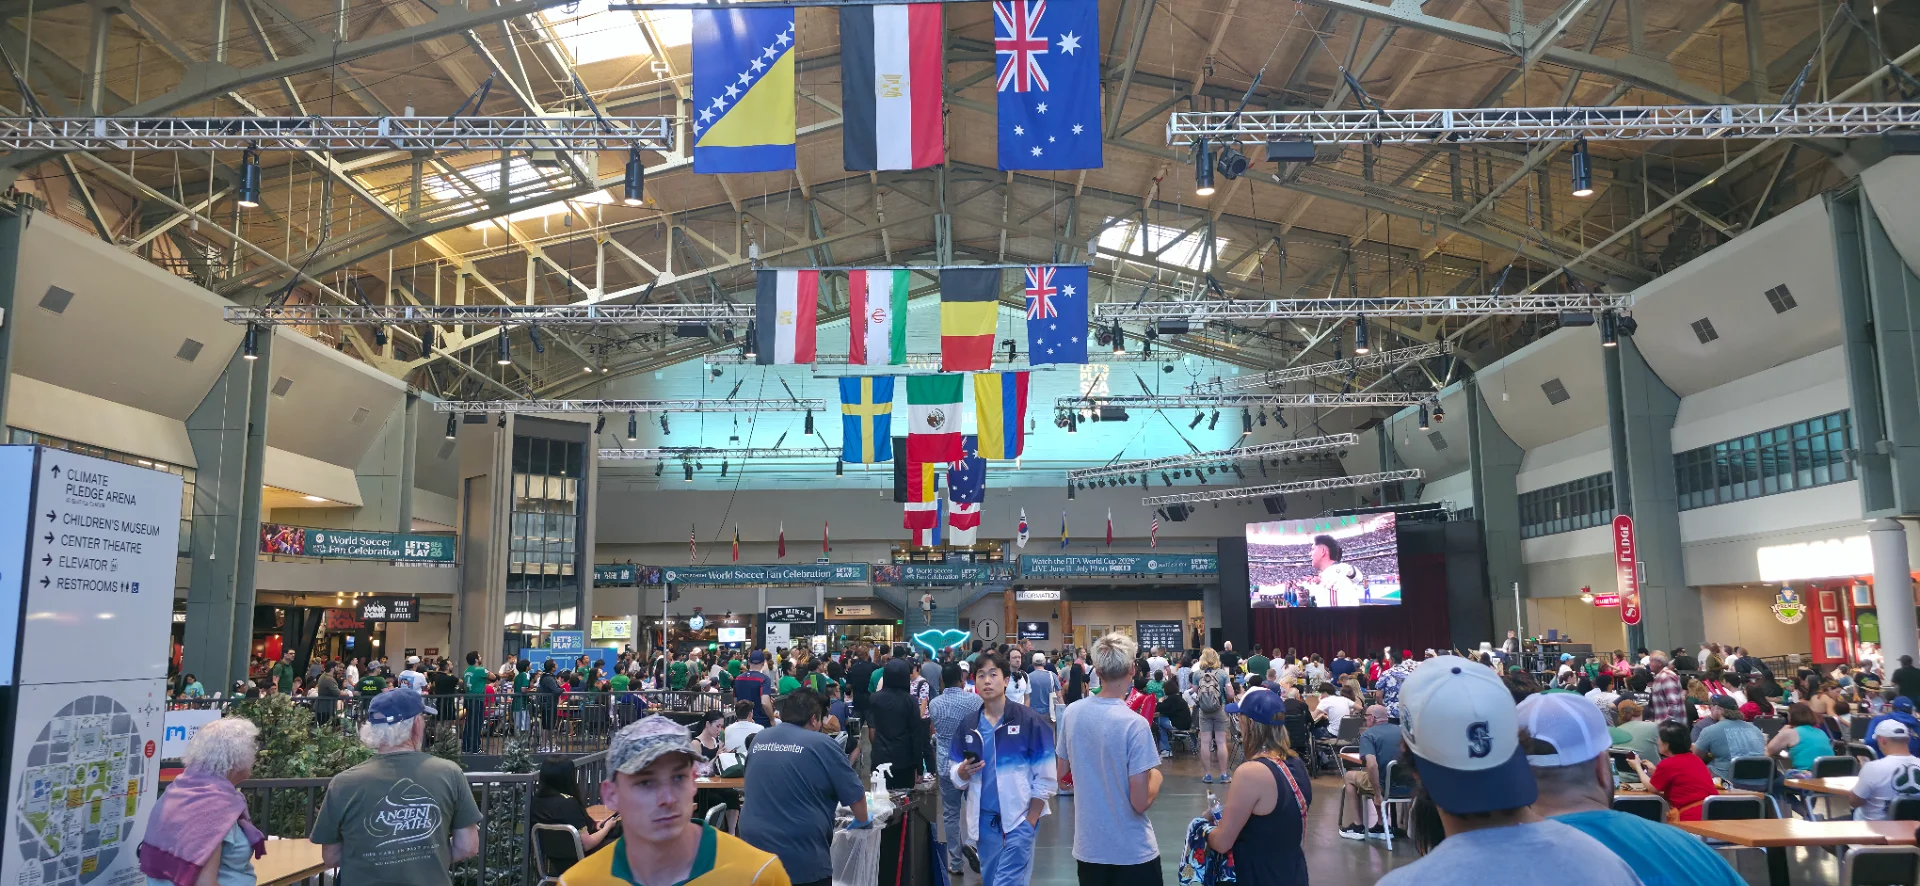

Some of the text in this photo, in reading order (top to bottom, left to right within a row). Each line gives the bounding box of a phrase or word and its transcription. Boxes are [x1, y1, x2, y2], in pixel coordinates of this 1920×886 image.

[1080, 364, 1109, 372] LET'S
[1080, 372, 1109, 380] PLAY
[67, 469, 108, 487] CLIMATE
[66, 483, 104, 500] PLEDGE
[106, 491, 136, 506] ARENA
[63, 513, 160, 536] CHILDREN'S MUSEUM
[61, 534, 142, 554] CENTER THEATRE
[330, 535, 391, 546] World Soccer
[405, 541, 430, 549] LET'S
[1620, 524, 1631, 562] FUDGE
[328, 545, 346, 554] Fan
[348, 546, 400, 556] Celebration
[405, 549, 429, 557] PLAY
[430, 548, 442, 557] 26
[59, 556, 108, 571] ELEVATOR
[1103, 558, 1116, 566] Cup
[708, 571, 732, 579] World
[735, 571, 764, 579] Soccer
[766, 570, 782, 579] Fan
[783, 569, 831, 578] Celebration
[57, 578, 118, 592] RESTROOMS
[770, 609, 812, 619] BIG MIKE'S
[375, 805, 431, 822] ANCIENT
[393, 818, 432, 835] PATHS
